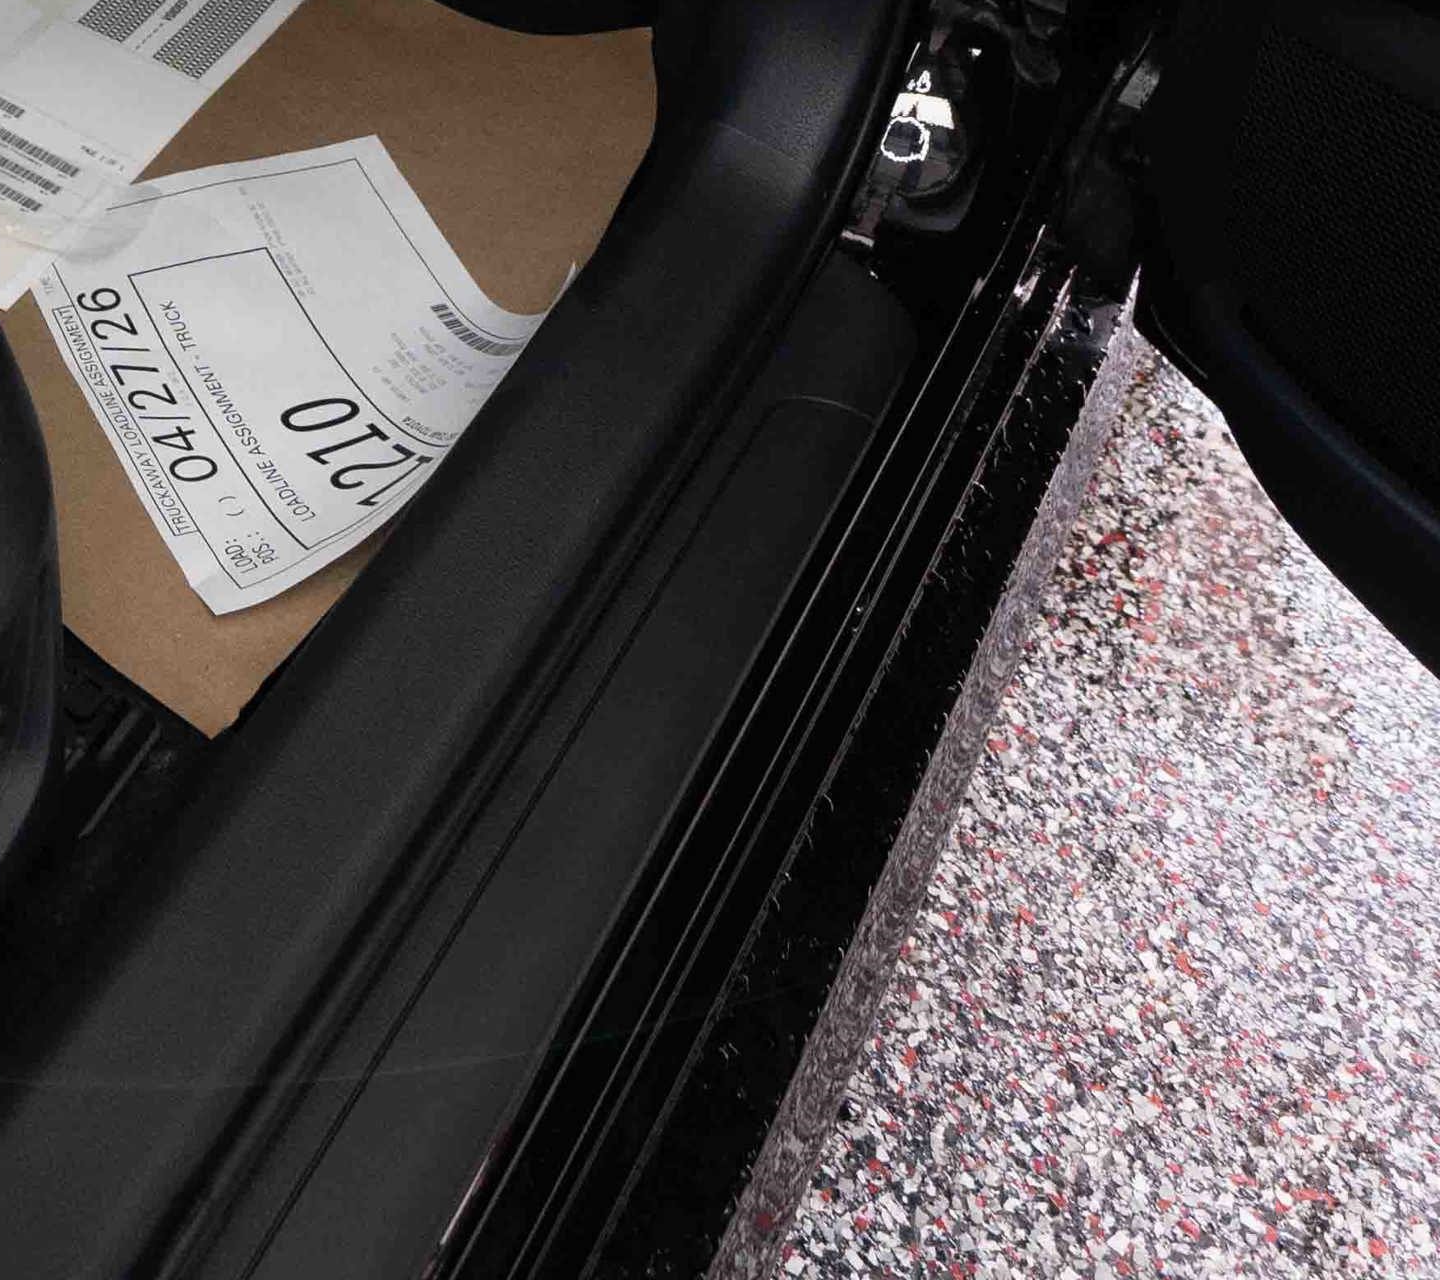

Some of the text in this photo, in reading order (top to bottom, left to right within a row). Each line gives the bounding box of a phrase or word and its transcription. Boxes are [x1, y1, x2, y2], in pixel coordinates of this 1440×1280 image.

[58, 309, 109, 387] ASSIGNMENT
[160, 300, 196, 354] TRUCK
[77, 287, 219, 483] 04/27/26
[98, 387, 141, 445] LOADLINE
[197, 365, 266, 456] ASSIGNMENT
[133, 449, 192, 533] TRUCKAWAY
[255, 453, 317, 523] LOADLINE
[279, 397, 434, 507] 1210
[223, 536, 259, 575] LOAD:
